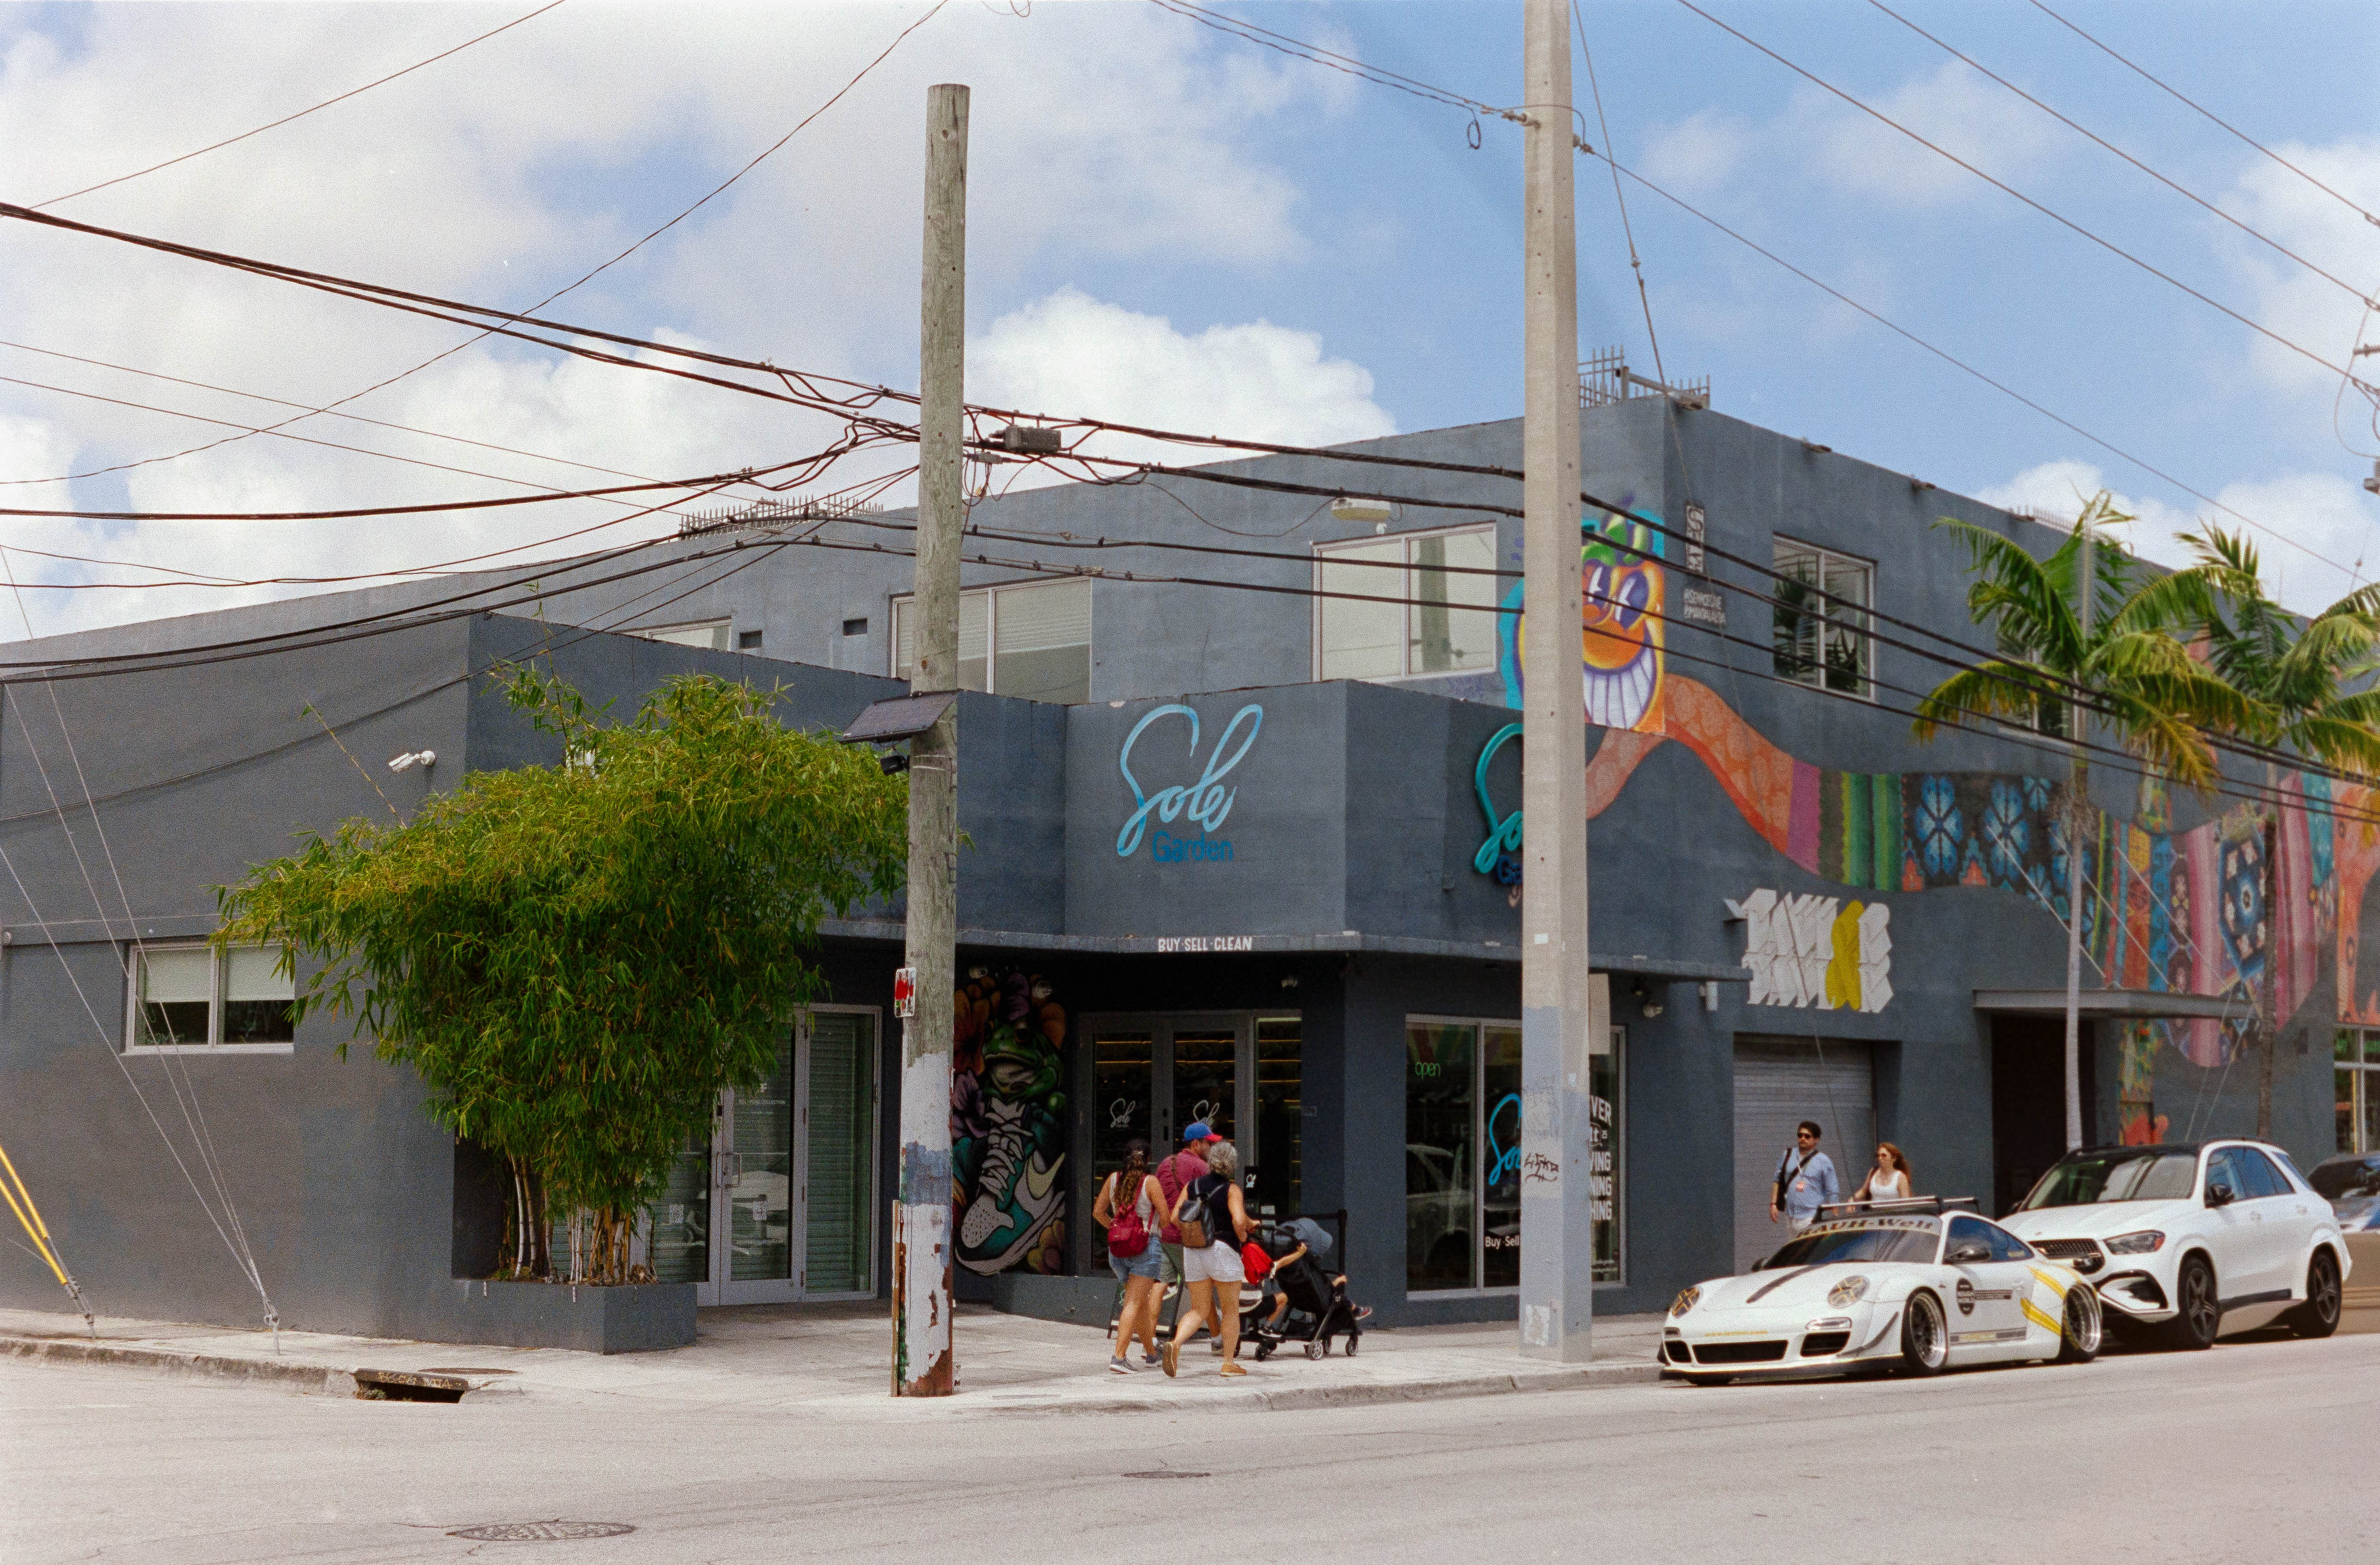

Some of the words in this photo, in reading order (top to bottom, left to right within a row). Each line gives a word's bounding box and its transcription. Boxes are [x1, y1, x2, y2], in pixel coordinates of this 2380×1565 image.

[1117, 704, 1263, 856] Sole
[1152, 830, 1233, 863] Garden
[1158, 937, 1181, 952] BUY
[1185, 937, 1208, 951] SELL
[1214, 936, 1253, 951] CLEAN
[1414, 1061, 1441, 1080] open
[1486, 1237, 1501, 1250] Buy
